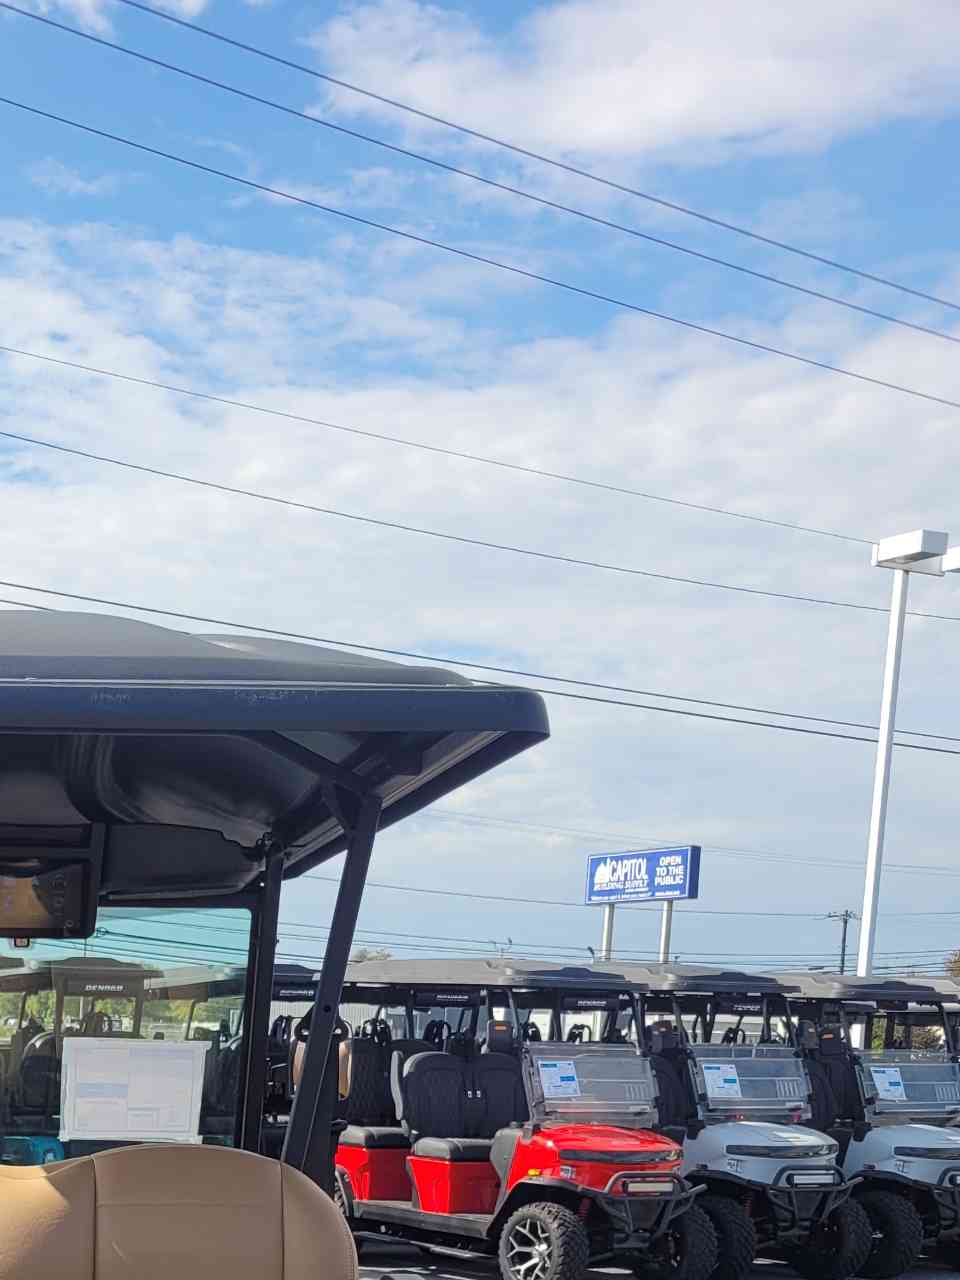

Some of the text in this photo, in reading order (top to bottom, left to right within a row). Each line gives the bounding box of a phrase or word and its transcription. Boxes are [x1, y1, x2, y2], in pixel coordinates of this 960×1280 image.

[660, 855, 682, 866] OPEN
[609, 857, 648, 880] CAPITOL
[656, 865, 684, 876] TO THE
[655, 875, 684, 886] PUBLIC
